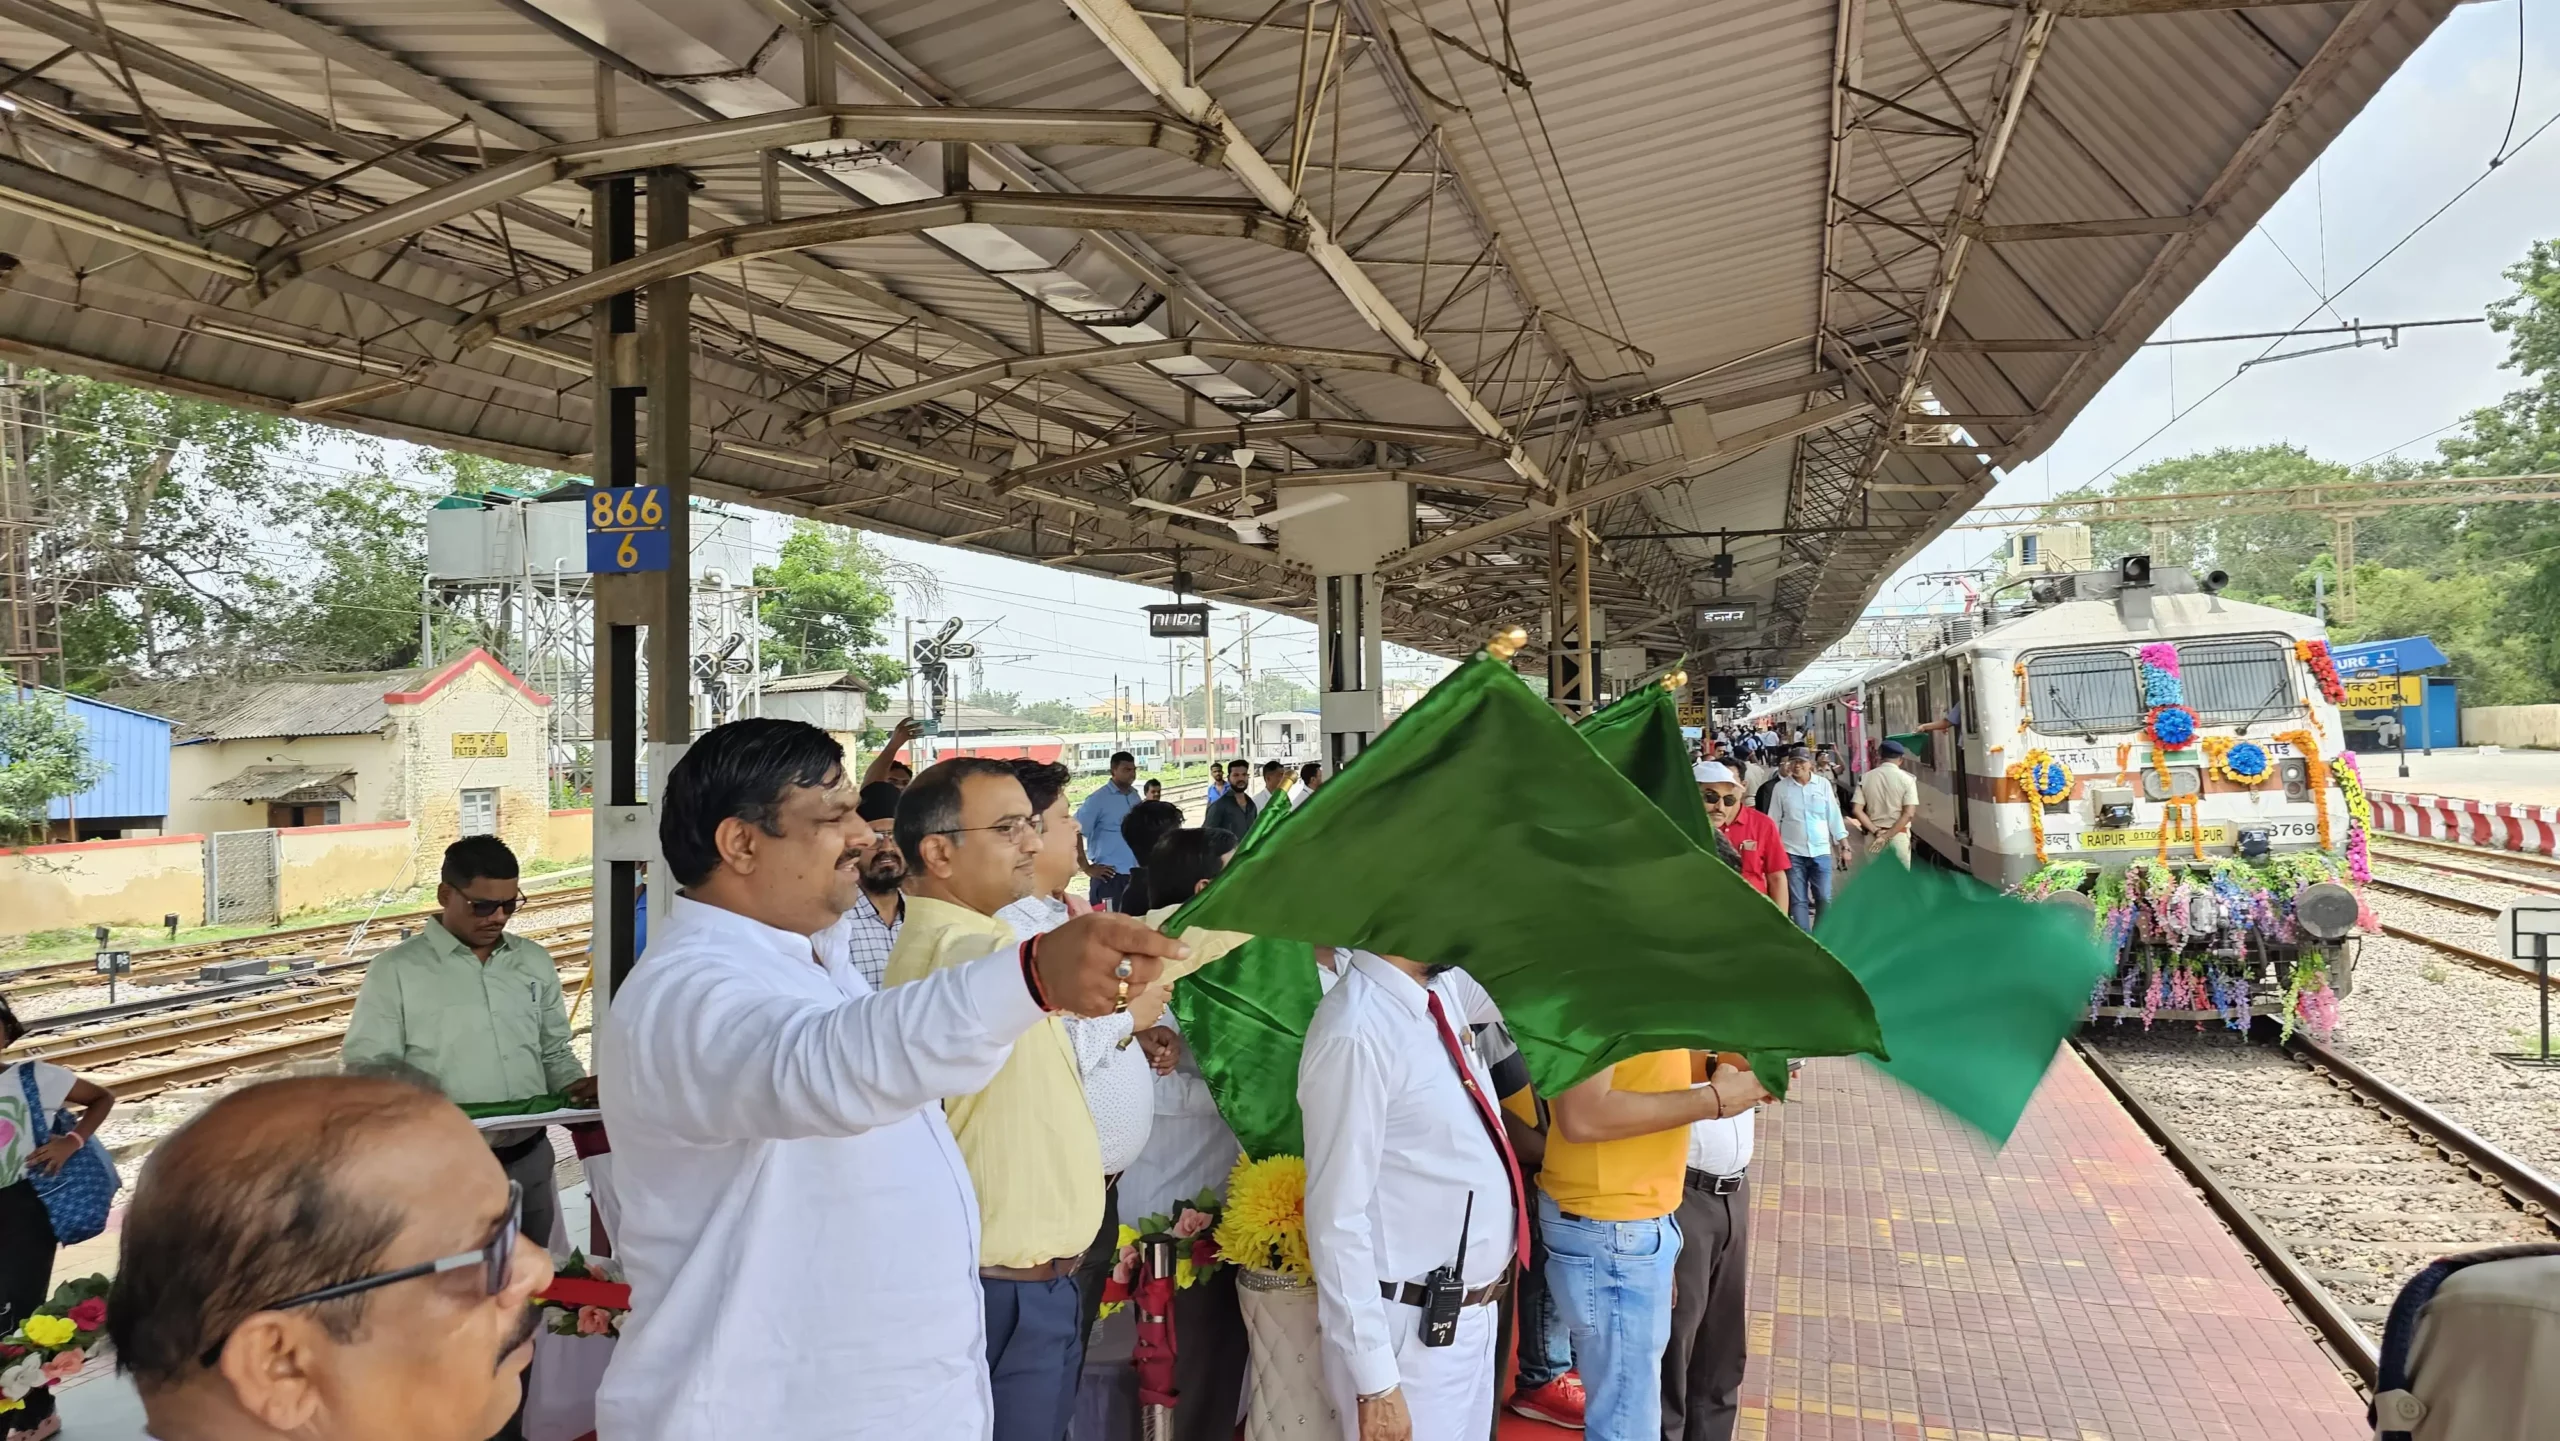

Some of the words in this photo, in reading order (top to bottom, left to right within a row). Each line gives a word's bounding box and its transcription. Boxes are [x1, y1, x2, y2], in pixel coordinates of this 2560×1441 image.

[592, 488, 663, 528] 866
[617, 533, 638, 569] 6
[2336, 656, 2369, 669] URG
[1767, 679, 1776, 690] 2
[454, 746, 478, 756] FILTER
[481, 745, 505, 756] HOUSE
[2087, 833, 2127, 847] RAIPUR
[2173, 829, 2224, 843] JABLPUR
